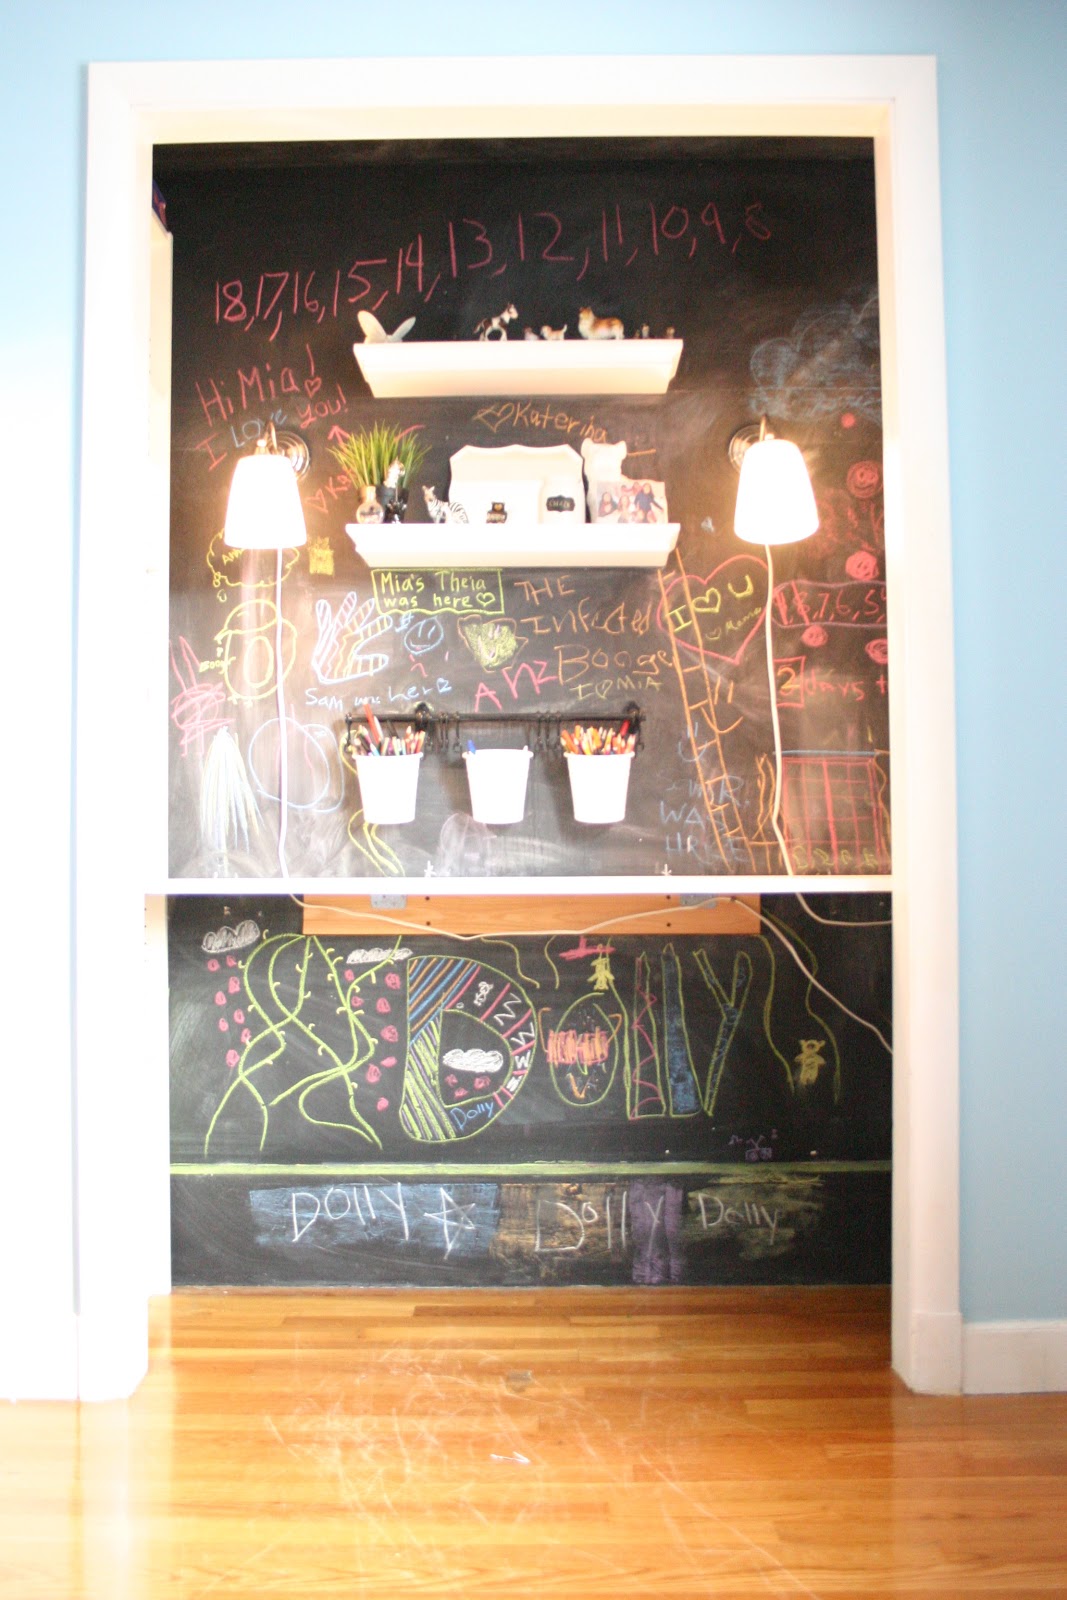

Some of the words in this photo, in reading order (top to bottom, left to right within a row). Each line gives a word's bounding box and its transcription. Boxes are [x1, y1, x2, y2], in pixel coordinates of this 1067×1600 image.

[383, 595, 418, 608] was
[433, 593, 474, 609] here
[450, 1101, 495, 1131] Dolly
